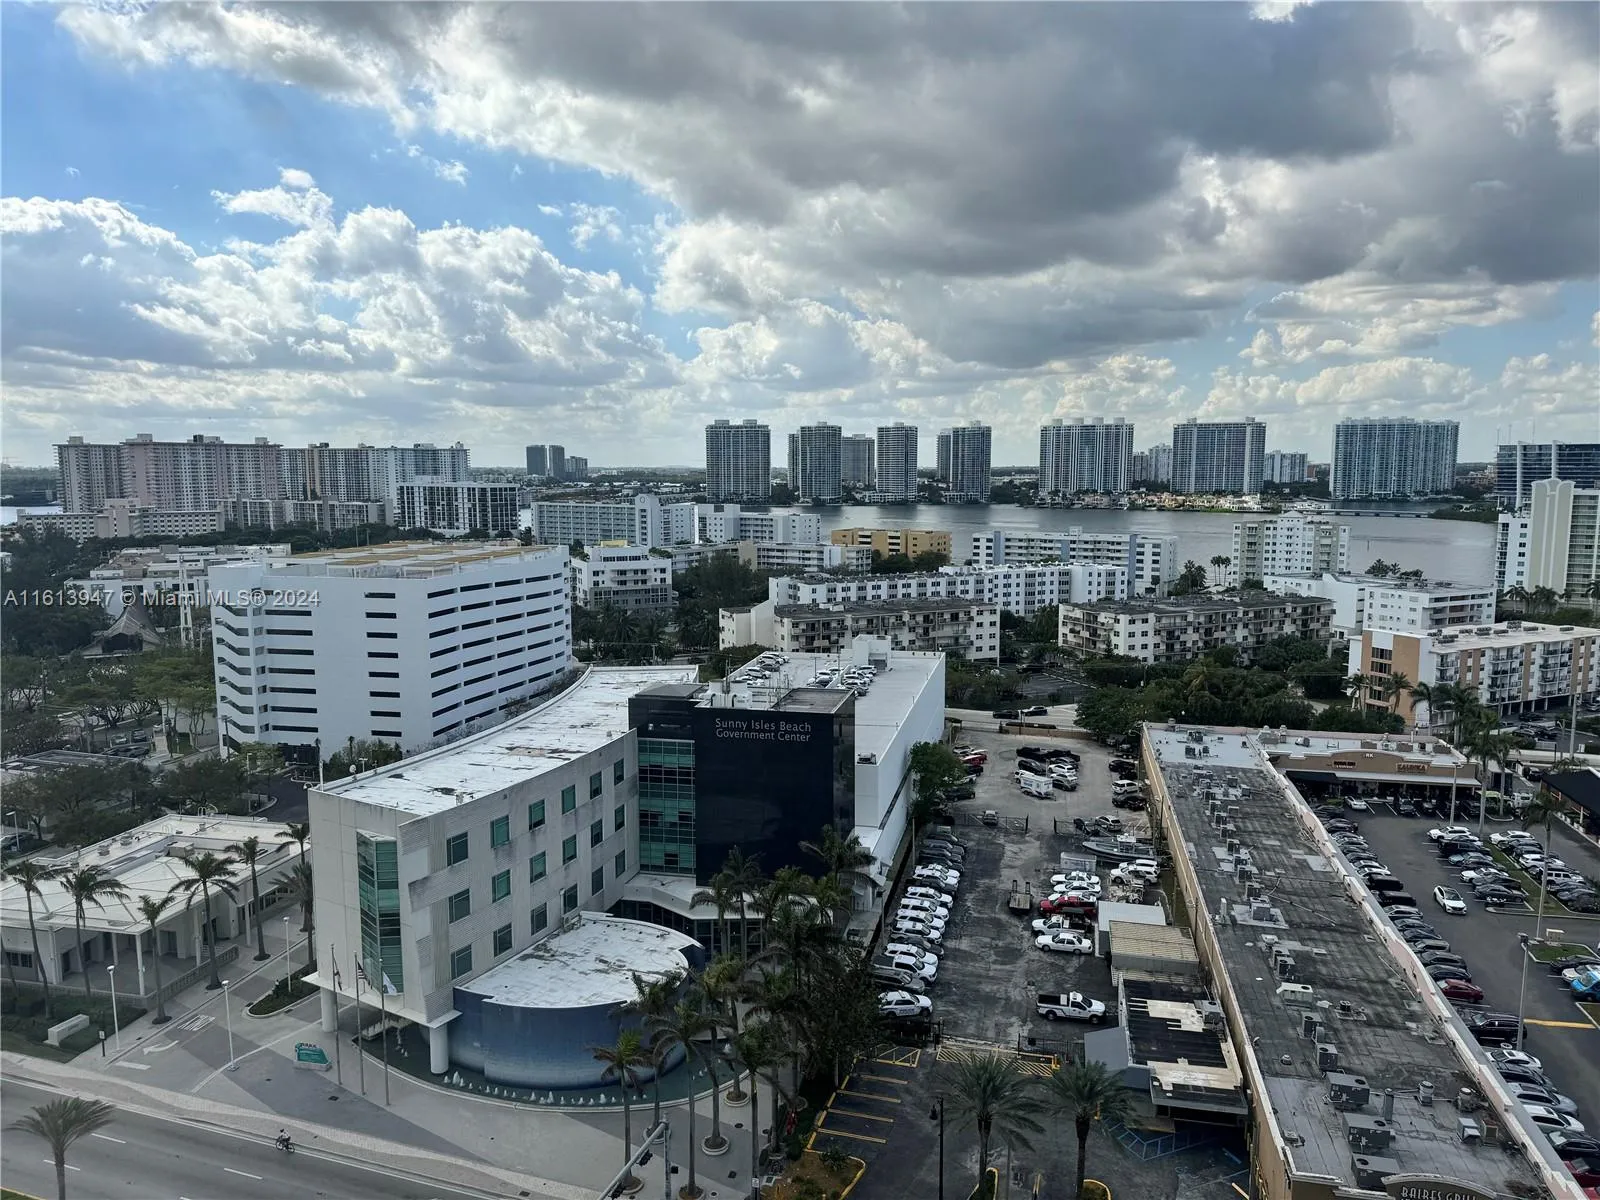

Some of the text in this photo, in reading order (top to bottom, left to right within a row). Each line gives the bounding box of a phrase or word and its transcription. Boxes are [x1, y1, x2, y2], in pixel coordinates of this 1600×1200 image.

[715, 718, 811, 732] Sunny Isles Beach
[716, 728, 811, 742] Government Center
[1401, 1186, 1442, 1200] BAIRES
